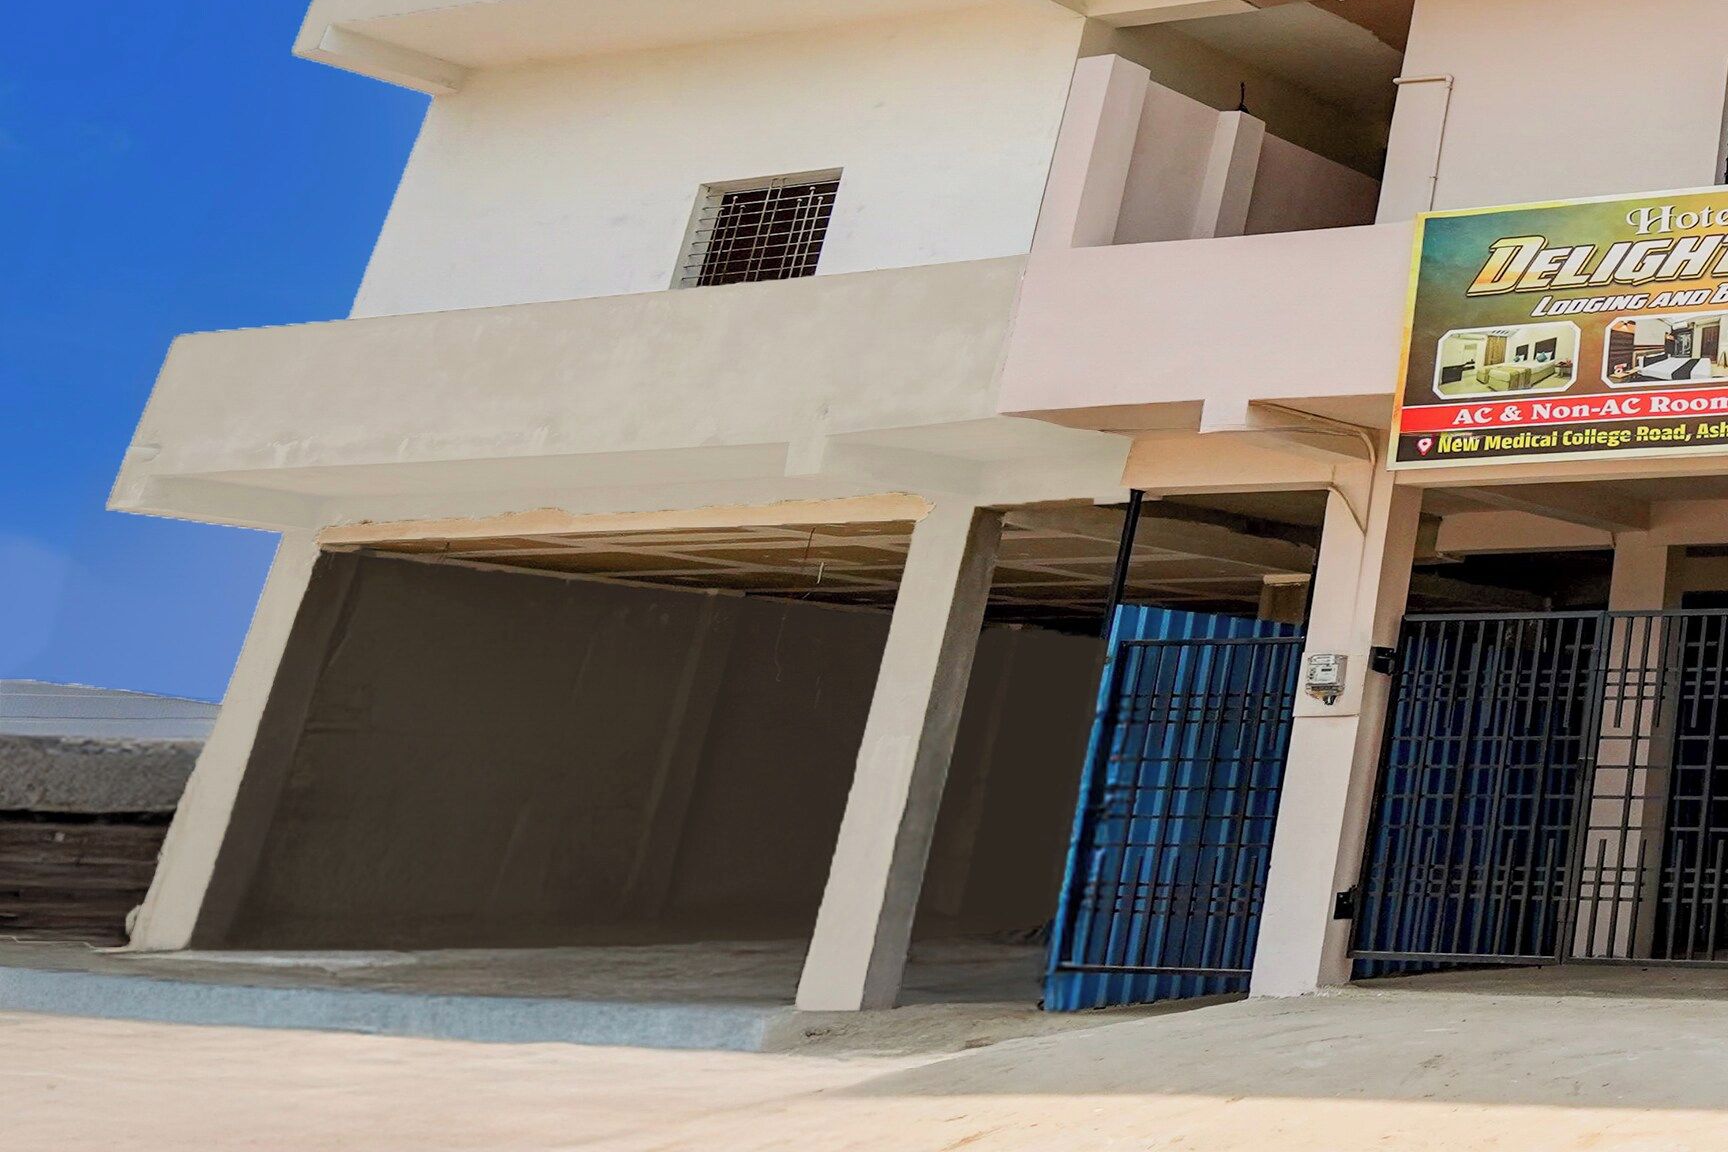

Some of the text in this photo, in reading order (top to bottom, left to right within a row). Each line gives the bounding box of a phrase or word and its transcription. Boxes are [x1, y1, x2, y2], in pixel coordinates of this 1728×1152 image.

[1530, 293, 1650, 318] LODGING
[1654, 288, 1712, 310] AND
[1452, 407, 1494, 426] AC
[1499, 405, 1523, 423] &
[1531, 397, 1641, 421] Non-AC
[1437, 433, 1480, 454] New
[1484, 432, 1557, 450] Medical
[1562, 428, 1632, 447] College
[1636, 424, 1692, 442] Road,
